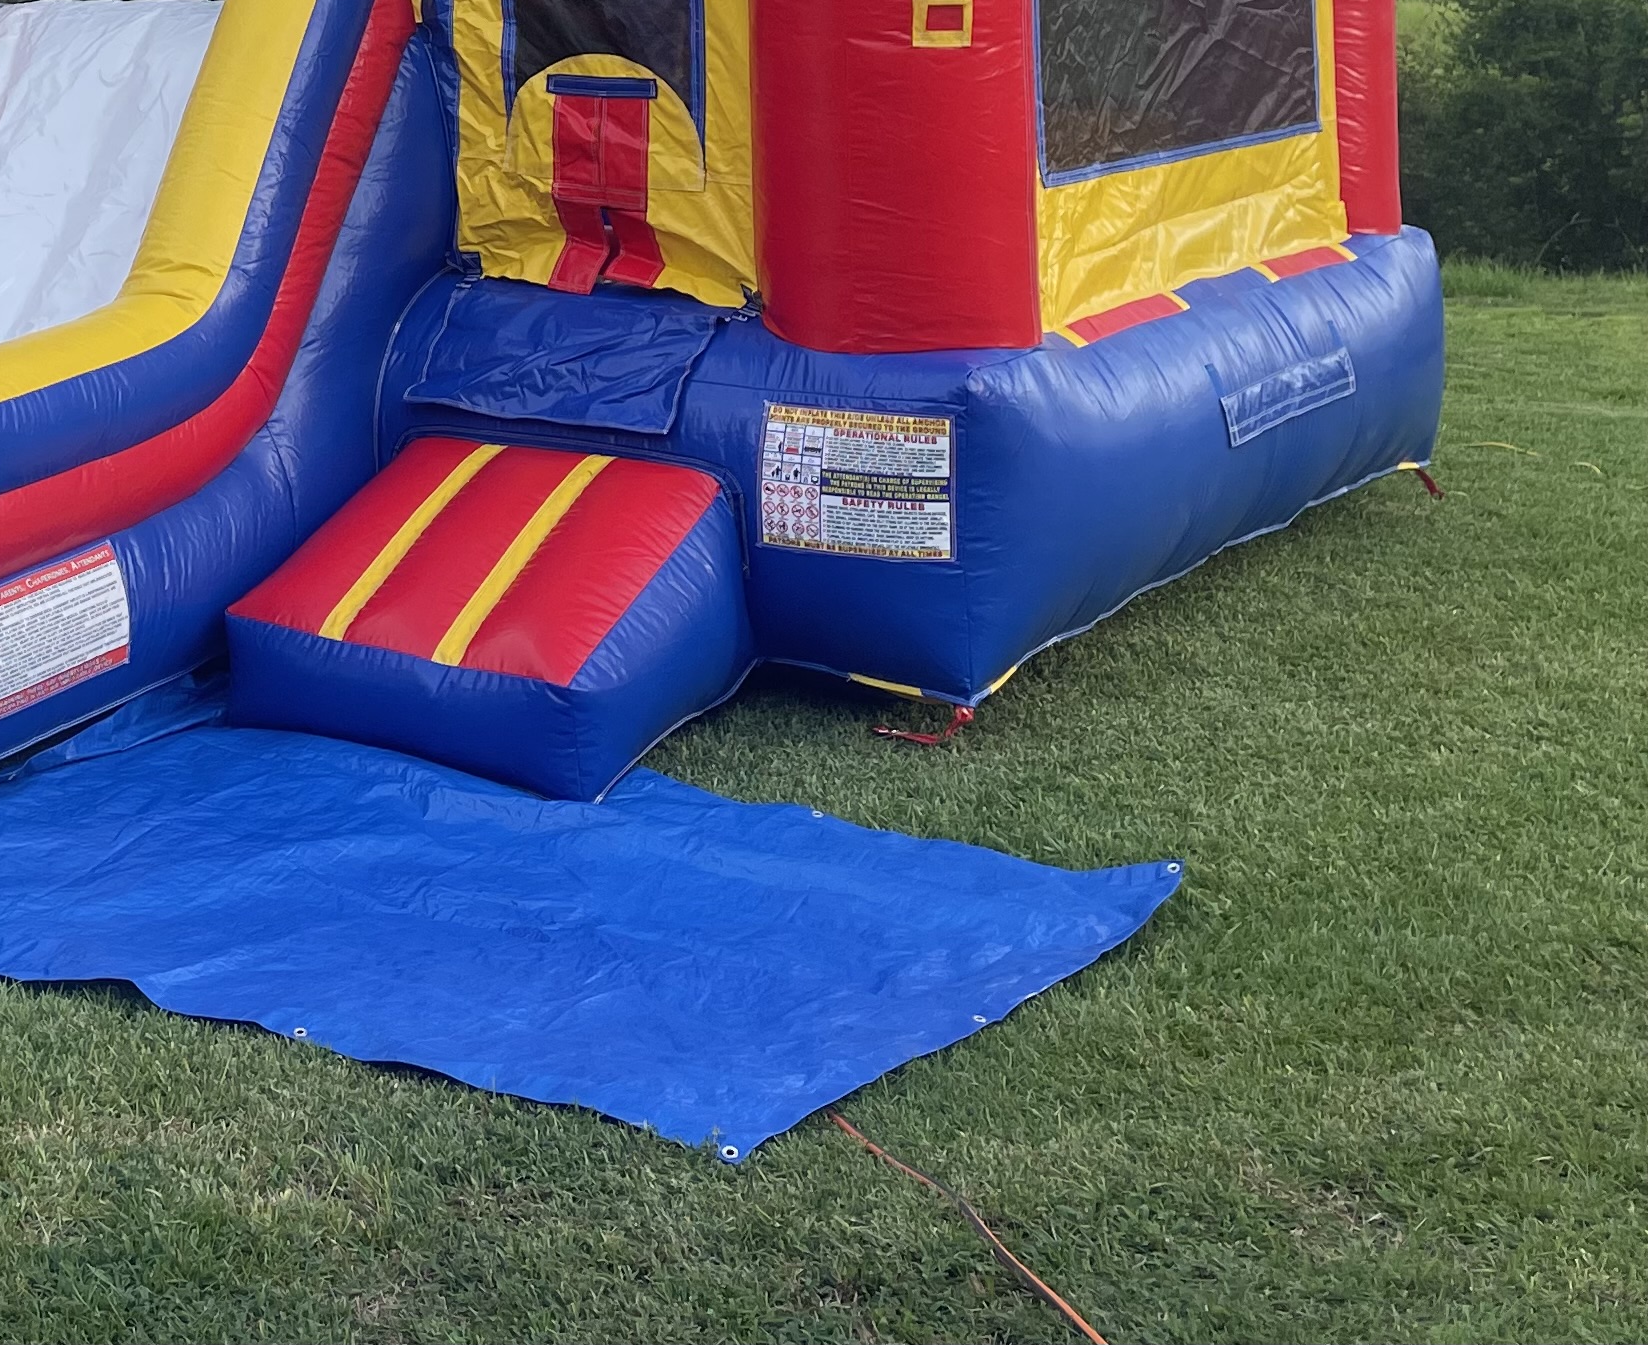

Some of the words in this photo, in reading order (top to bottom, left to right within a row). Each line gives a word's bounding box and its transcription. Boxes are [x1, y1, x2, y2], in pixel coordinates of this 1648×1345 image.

[812, 418, 847, 427] PROPERLY
[849, 421, 882, 429] SECURED
[913, 426, 946, 434] GROUND
[913, 418, 946, 426] ANCHOR
[834, 429, 901, 442] OPERATIONAL
[904, 436, 937, 444] RULES
[842, 498, 884, 508] SAFETY
[888, 501, 925, 510] RULES
[804, 541, 824, 549] MUST
[838, 546, 887, 555] SUPERVISED
